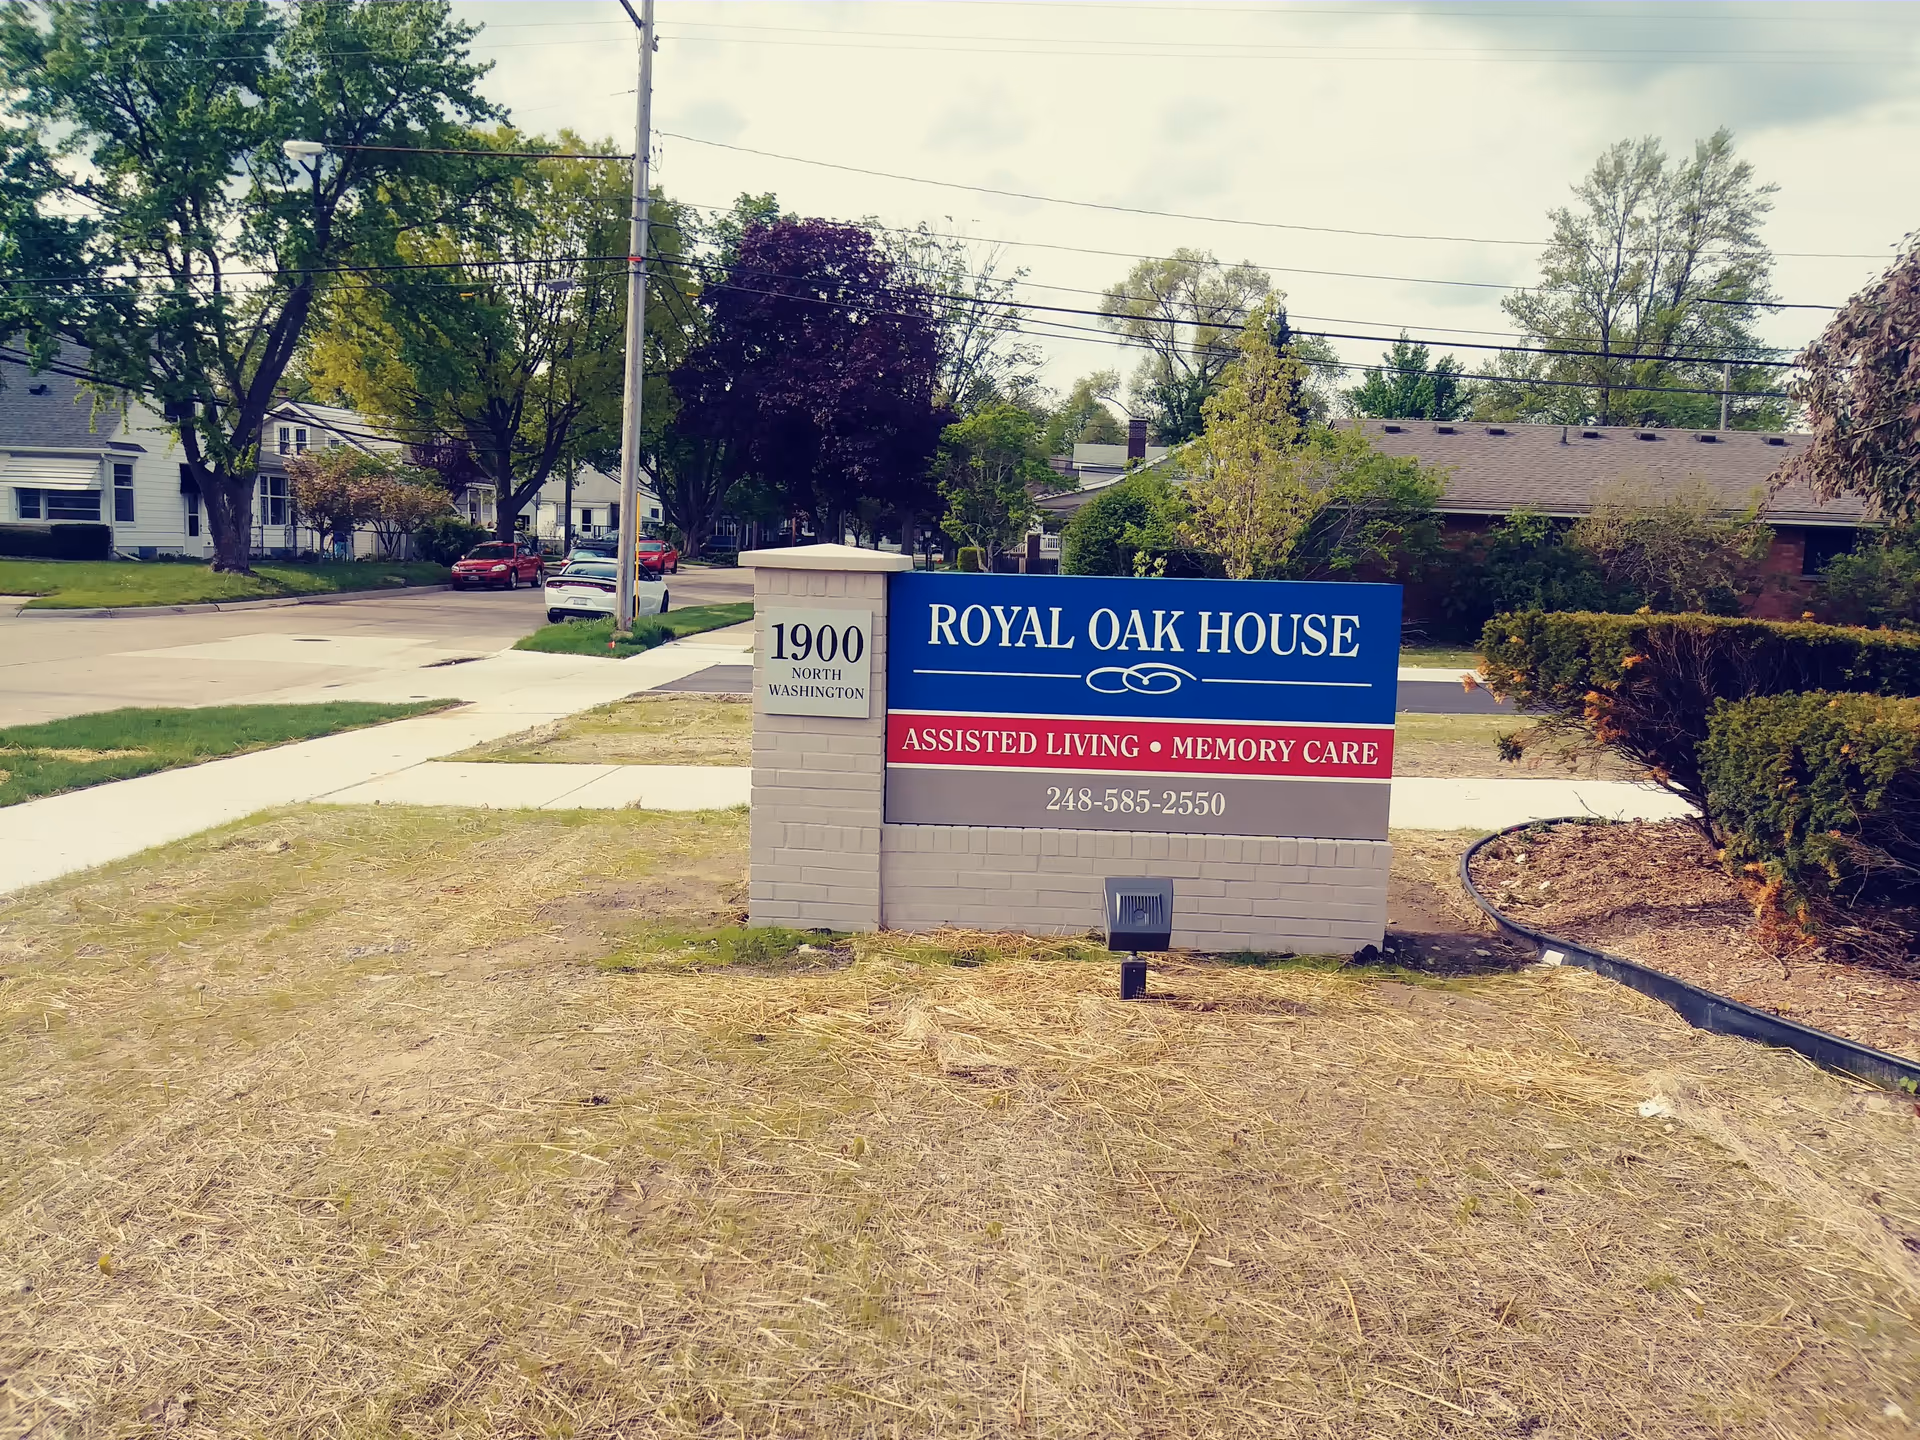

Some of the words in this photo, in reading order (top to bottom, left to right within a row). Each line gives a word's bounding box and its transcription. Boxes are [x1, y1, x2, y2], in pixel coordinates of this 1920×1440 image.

[770, 622, 865, 665] 1900
[927, 602, 1076, 650] ROYAL
[1088, 607, 1186, 653] OAK
[1195, 611, 1361, 659] HOUSE
[791, 667, 842, 681] NORTH
[767, 683, 866, 701] WASHINGTON
[901, 727, 1038, 755] ASSISTED
[1045, 731, 1140, 759] LIVING
[1169, 736, 1297, 764] MEMORY
[1302, 740, 1380, 766] CARE
[1045, 785, 1227, 817] 248-585-2550
